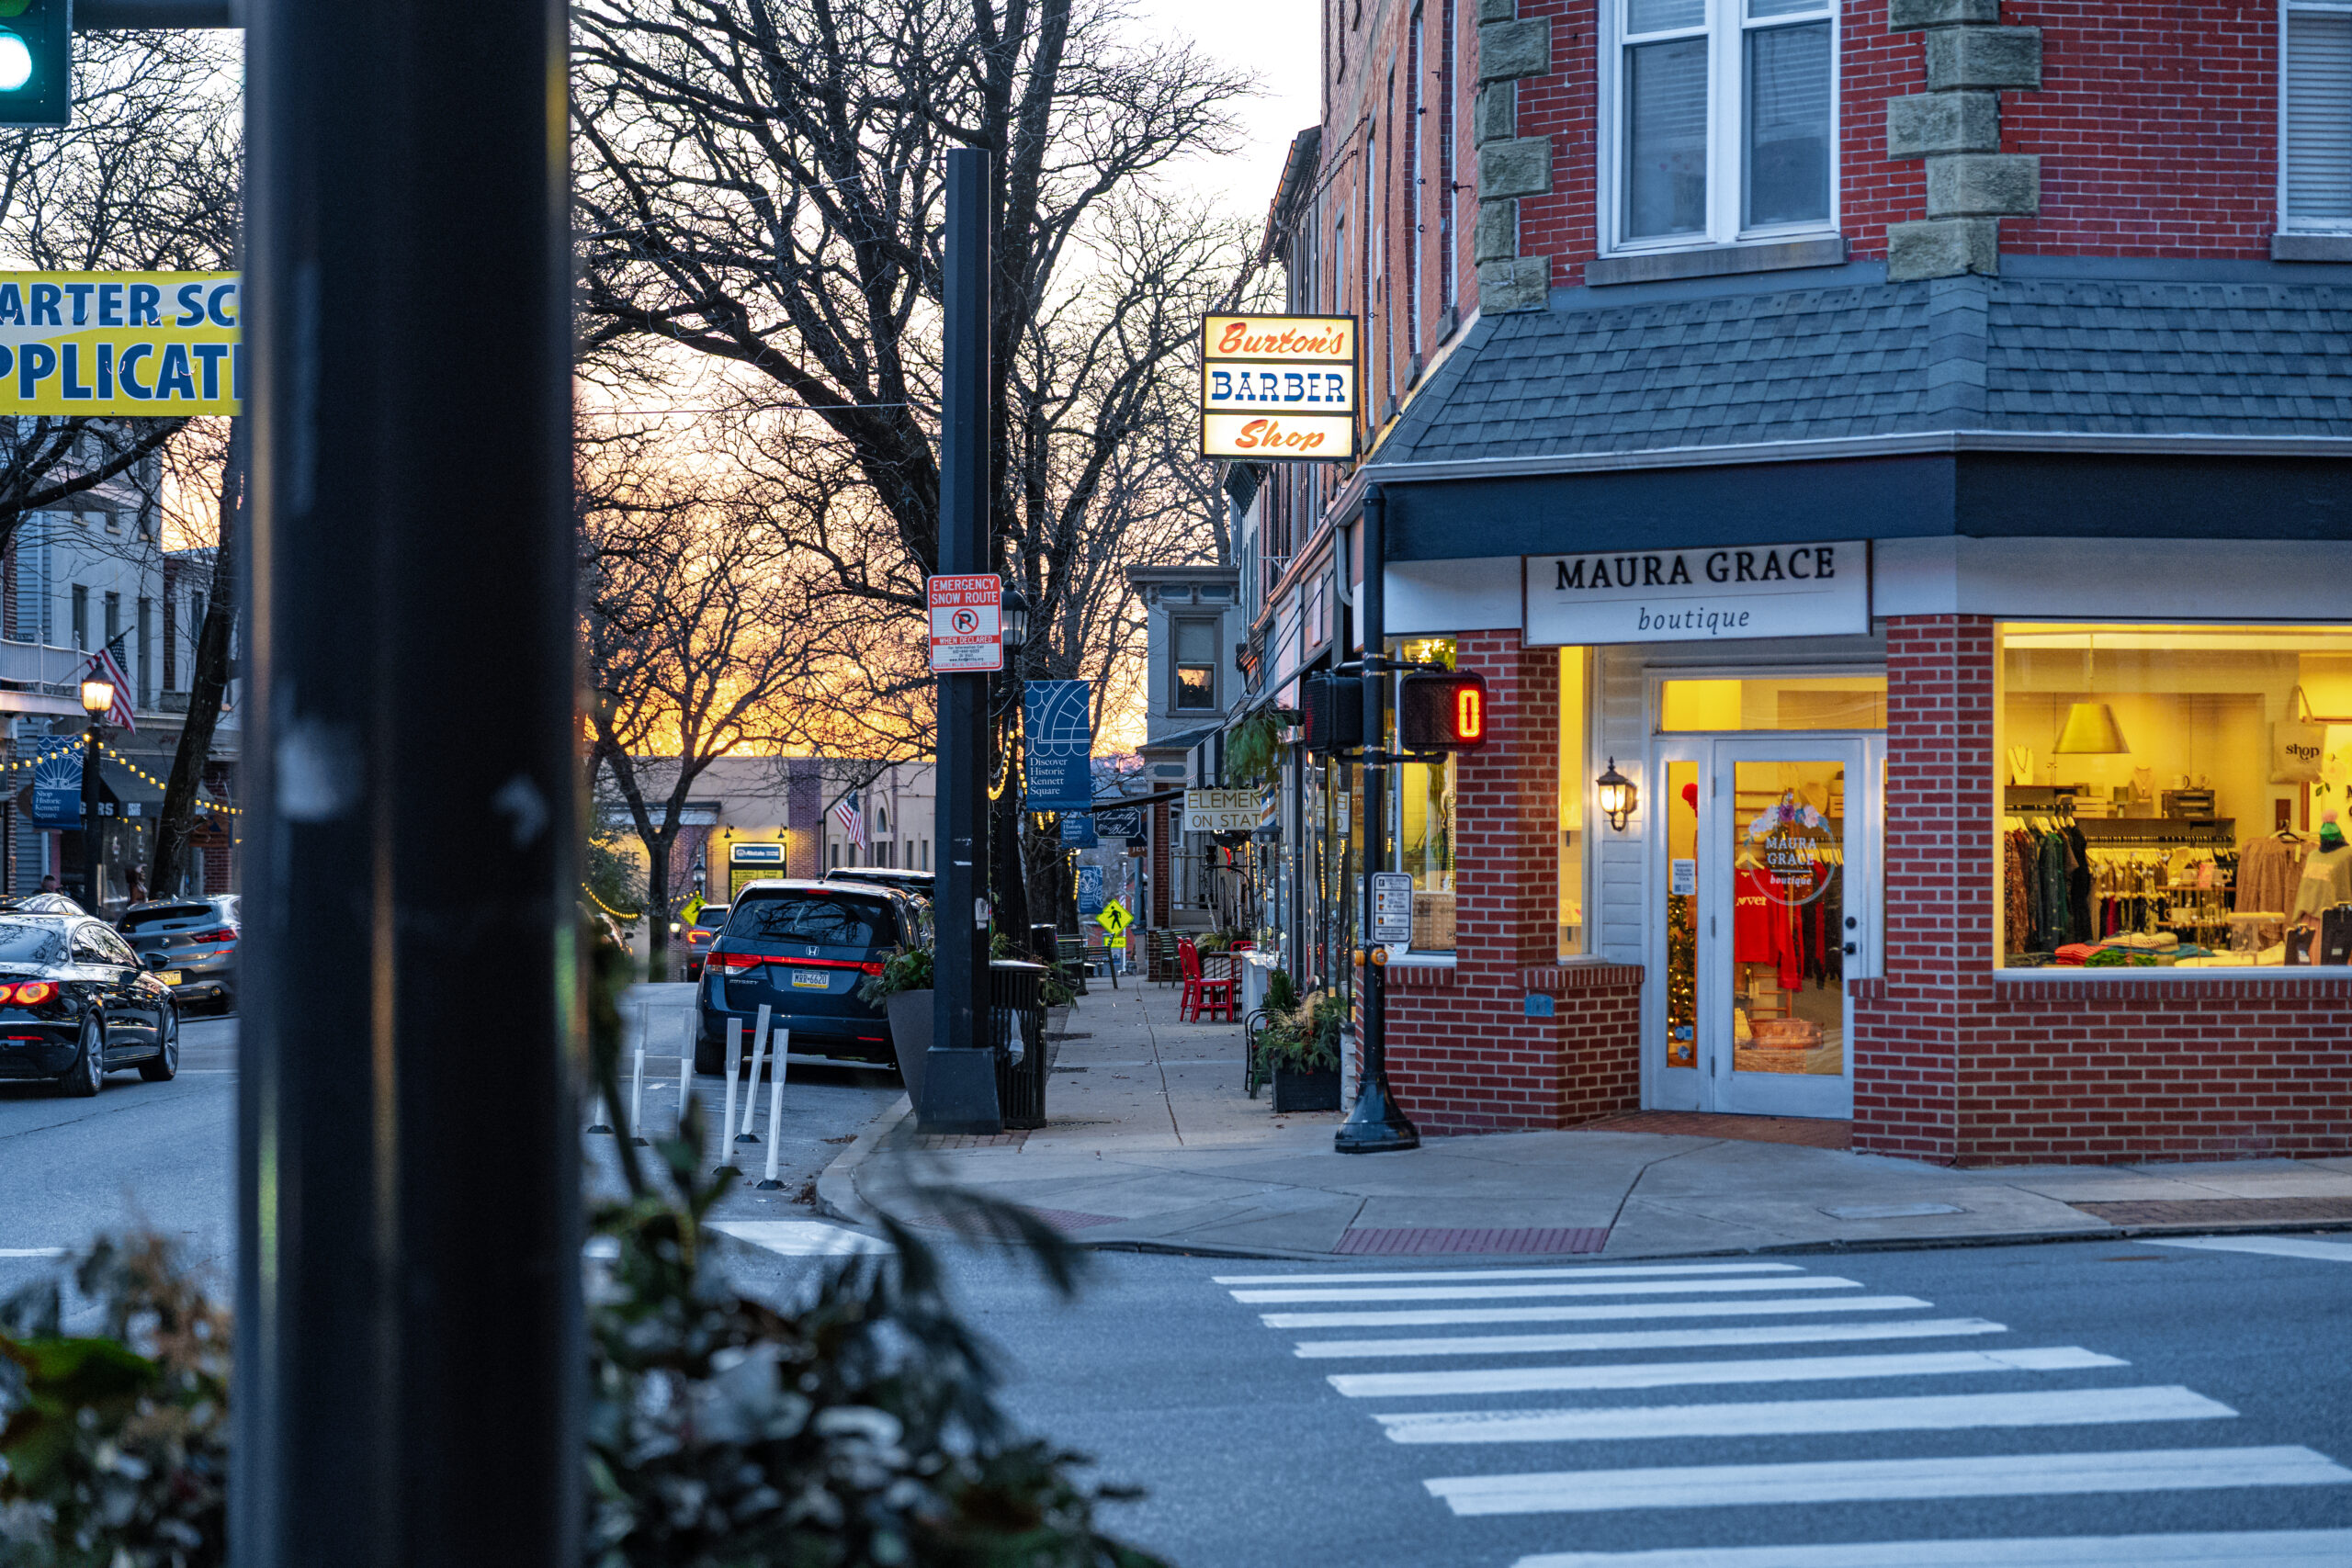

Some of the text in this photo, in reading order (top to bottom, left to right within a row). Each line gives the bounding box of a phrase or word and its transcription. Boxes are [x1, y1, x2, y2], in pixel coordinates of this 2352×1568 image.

[175, 283, 242, 328] SC
[1218, 321, 1345, 355] Burton's
[1211, 371, 1346, 402] BARBER
[1235, 419, 1325, 451] Shop
[1555, 547, 1836, 590] MAURA GRACE
[933, 578, 996, 592] EMERGENCY
[932, 591, 999, 604] SNOW ROUTE
[1638, 606, 1750, 636] boutique
[939, 635, 993, 645] WHEN DECLARED
[2286, 743, 2320, 761] shop
[1030, 757, 1069, 766] Discover
[1030, 767, 1065, 775] Historic
[1030, 776, 1065, 785] Kennett
[36, 790, 53, 798] Shop
[1030, 786, 1061, 797] Square
[1188, 792, 1261, 808] ELEMEN
[1192, 813, 1261, 828] ON STAT
[1765, 837, 1817, 850] MAURA
[1767, 852, 1815, 865] GRACE
[1770, 874, 1812, 887] boutique
